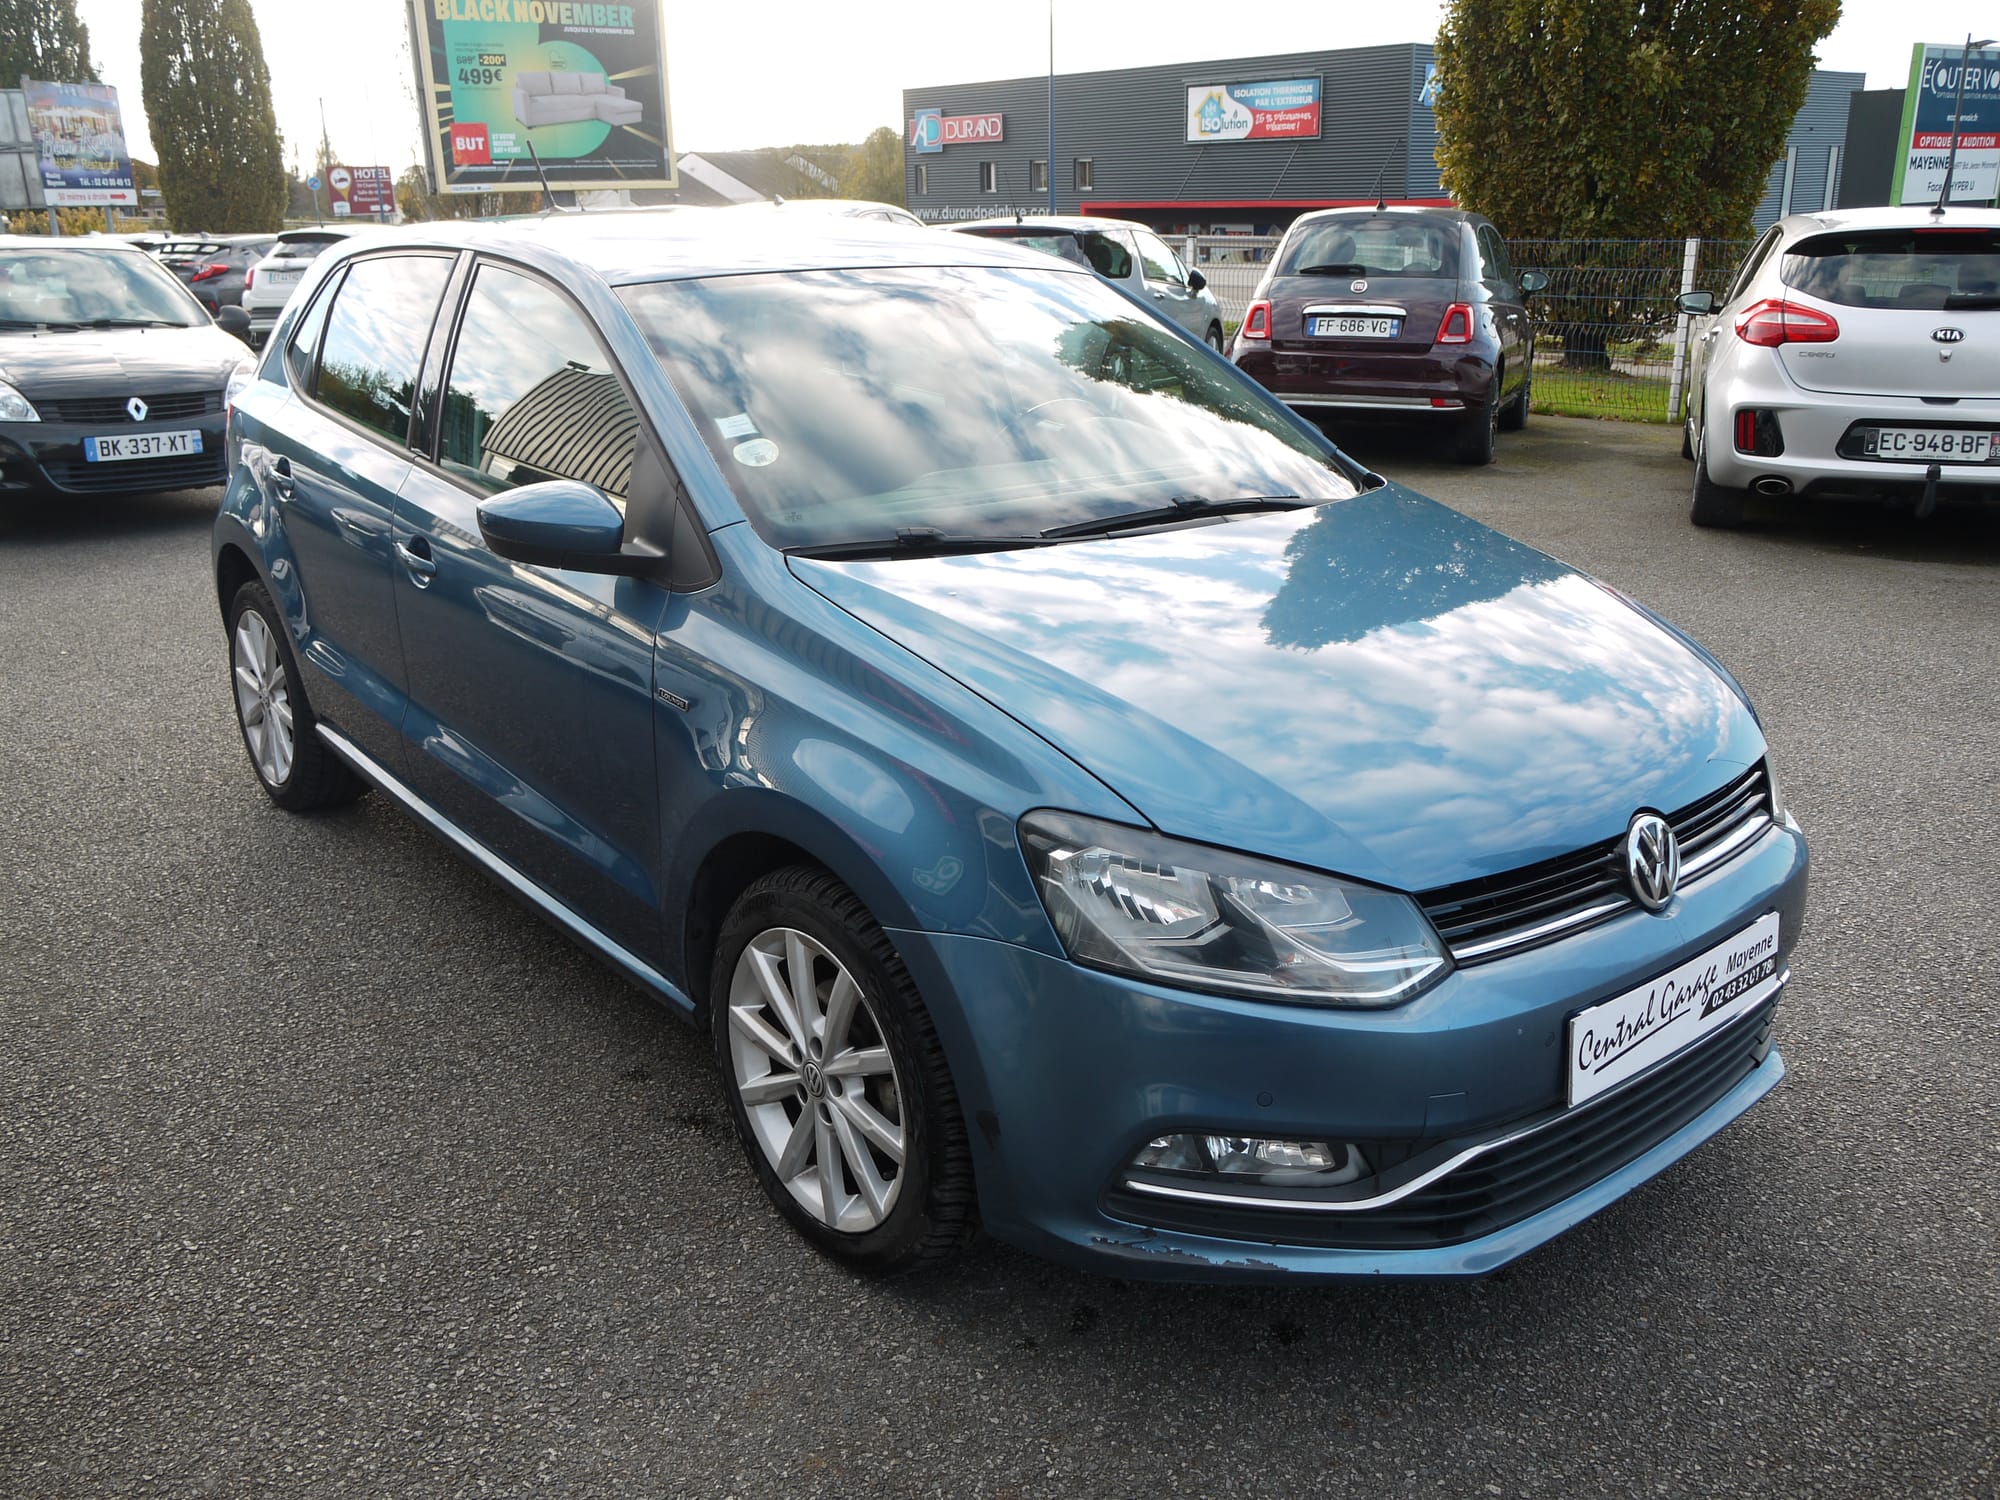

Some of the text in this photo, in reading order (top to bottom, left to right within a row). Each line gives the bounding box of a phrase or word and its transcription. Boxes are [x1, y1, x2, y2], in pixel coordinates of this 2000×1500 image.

[434, 0, 635, 28] BLACK NOVEMBER
[458, 68, 503, 85] 499€
[1984, 68, 2000, 90] VO
[1234, 87, 1271, 98] ISOLATION
[945, 118, 1001, 139] DURAND
[455, 137, 485, 151] BUT
[1920, 135, 1952, 147] OPTIQUE
[1962, 136, 1996, 147] AUDITION
[1909, 156, 1951, 170] MAYENNE
[353, 168, 390, 179] HOTEL
[1317, 319, 1388, 333] FF-686-VG
[1936, 330, 1961, 341] KIA
[100, 435, 188, 456] BK-337-XT
[1880, 433, 1989, 454] EC-948-BF
[1578, 934, 1773, 1071] Central Garage Mayenne
